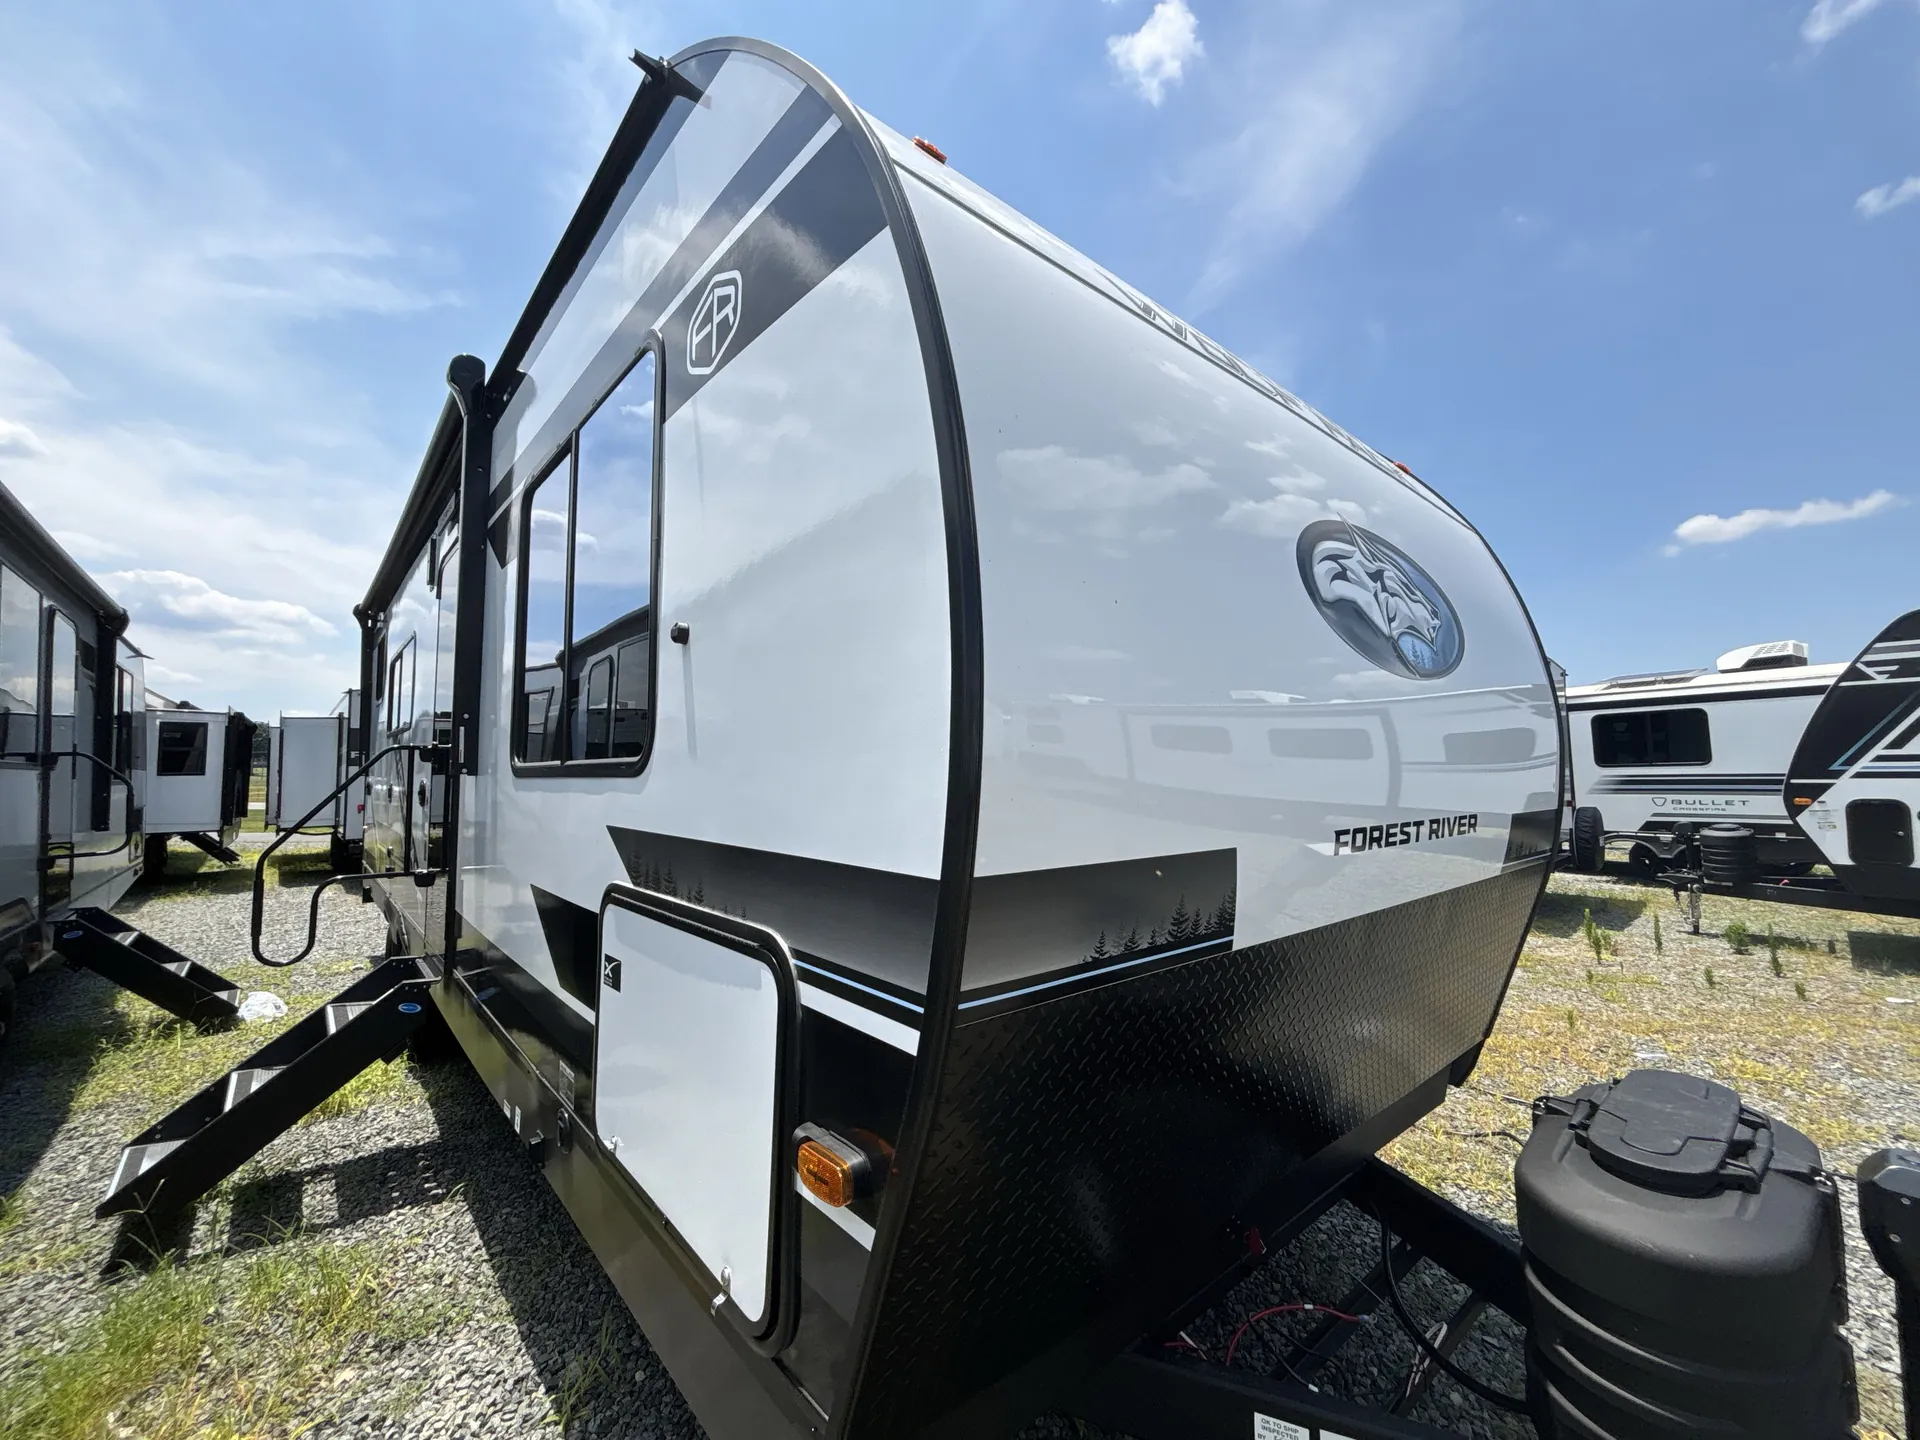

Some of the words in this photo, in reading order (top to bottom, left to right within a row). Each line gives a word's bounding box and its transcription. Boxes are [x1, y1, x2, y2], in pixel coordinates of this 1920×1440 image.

[1671, 799, 1750, 807] BULLET
[1333, 819, 1425, 857] FOREST
[1428, 813, 1478, 841] RIVER
[1261, 1418, 1271, 1426] OK
[1272, 1421, 1282, 1429] TO
[1283, 1425, 1299, 1434] SHIP
[1261, 1424, 1299, 1440] INSPECTED
